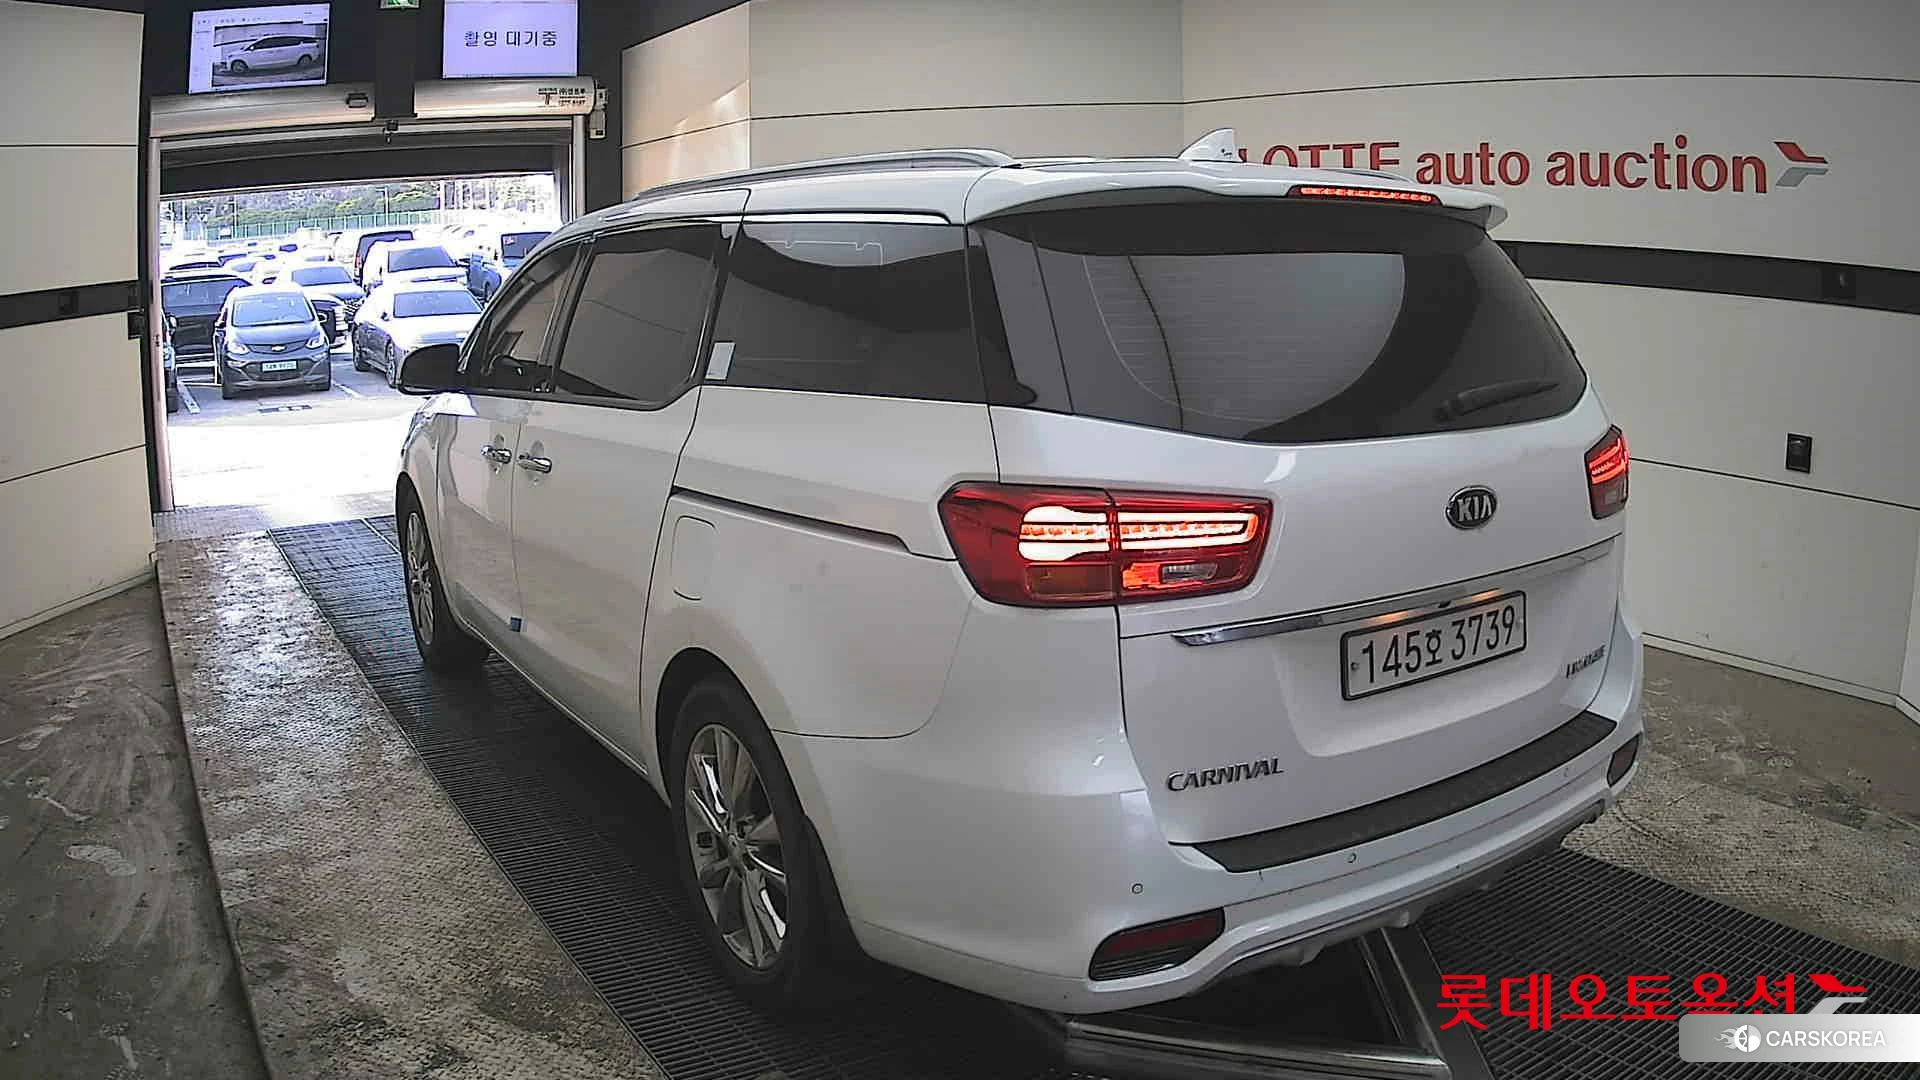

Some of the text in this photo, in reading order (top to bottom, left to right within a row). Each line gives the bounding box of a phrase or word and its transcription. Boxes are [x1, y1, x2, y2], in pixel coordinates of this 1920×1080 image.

[505, 31, 558, 48] 대기중
[1238, 134, 1767, 194] OTTE auto auction
[1456, 494, 1492, 522] KIA
[1361, 604, 1515, 684] 145호 3739
[1167, 757, 1285, 792] CARNIVAL
